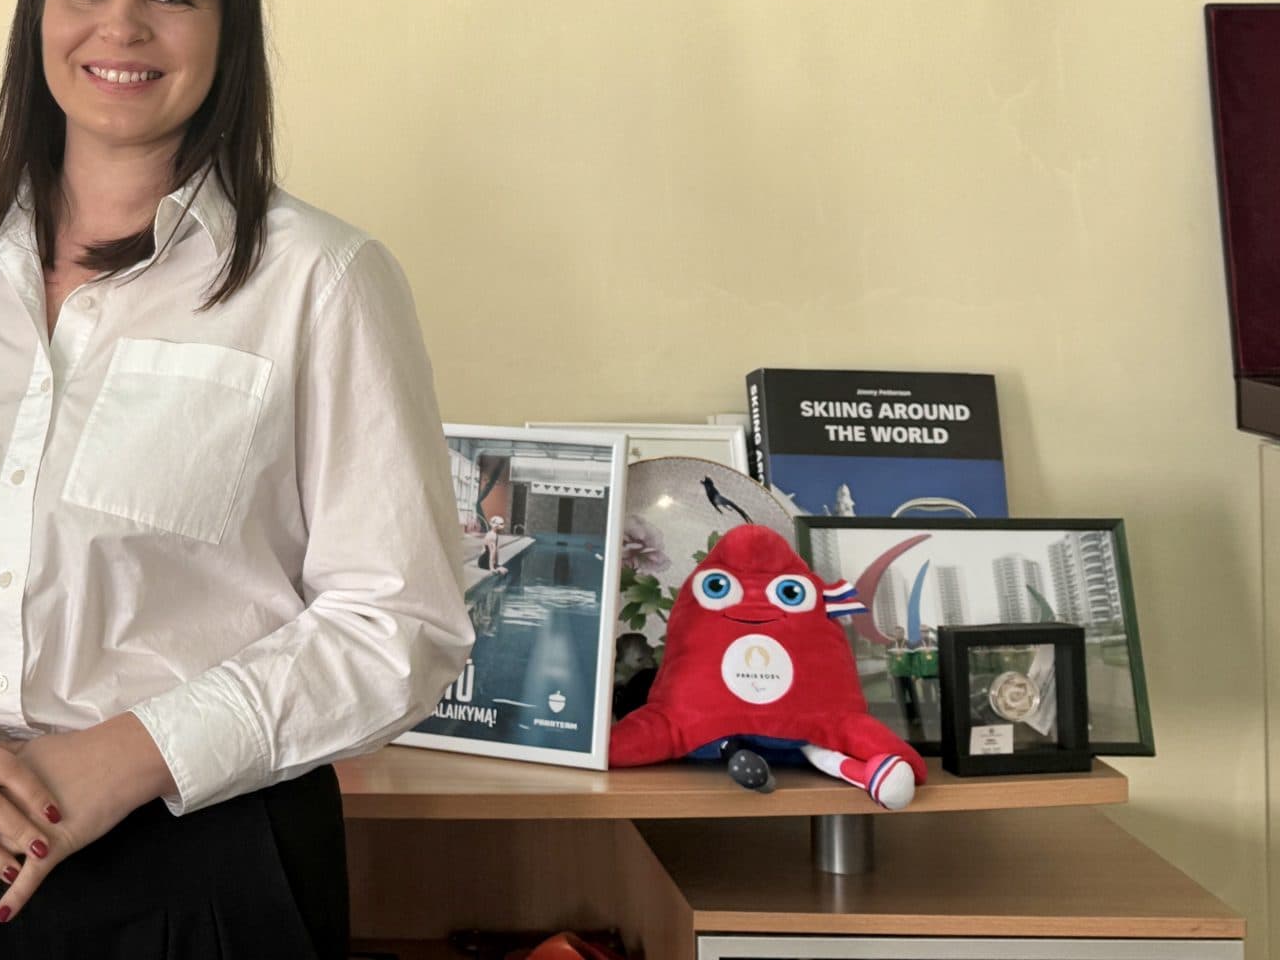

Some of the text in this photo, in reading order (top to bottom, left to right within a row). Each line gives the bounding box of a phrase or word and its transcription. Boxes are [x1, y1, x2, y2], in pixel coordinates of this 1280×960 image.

[749, 383, 762, 446] SKIING
[799, 400, 971, 421] SKIING AROUND
[824, 425, 949, 444] THE WORLD
